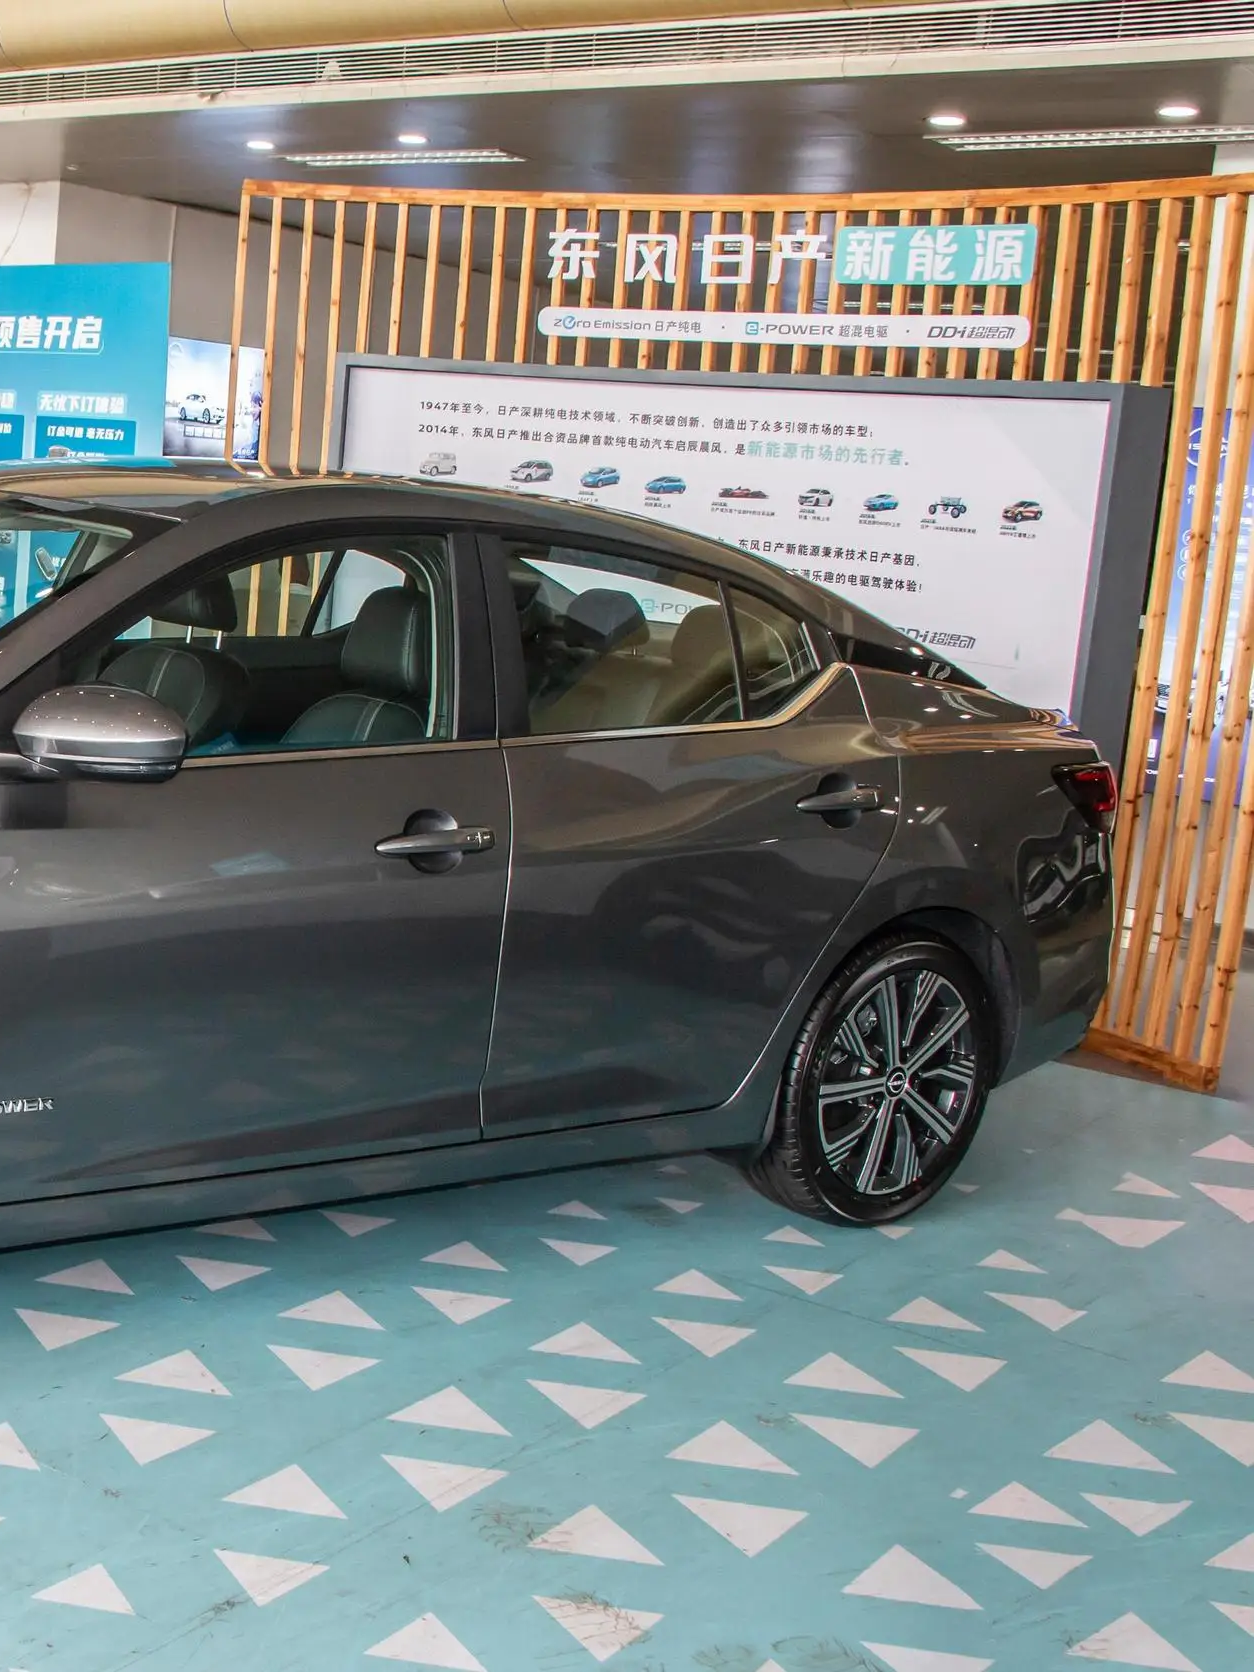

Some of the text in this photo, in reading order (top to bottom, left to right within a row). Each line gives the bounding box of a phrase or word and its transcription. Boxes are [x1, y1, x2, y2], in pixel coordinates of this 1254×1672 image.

[593, 318, 652, 331] Emission
[654, 319, 702, 335] 日产纯电
[745, 319, 835, 337] e-POWER
[838, 324, 889, 339] 超混电驱
